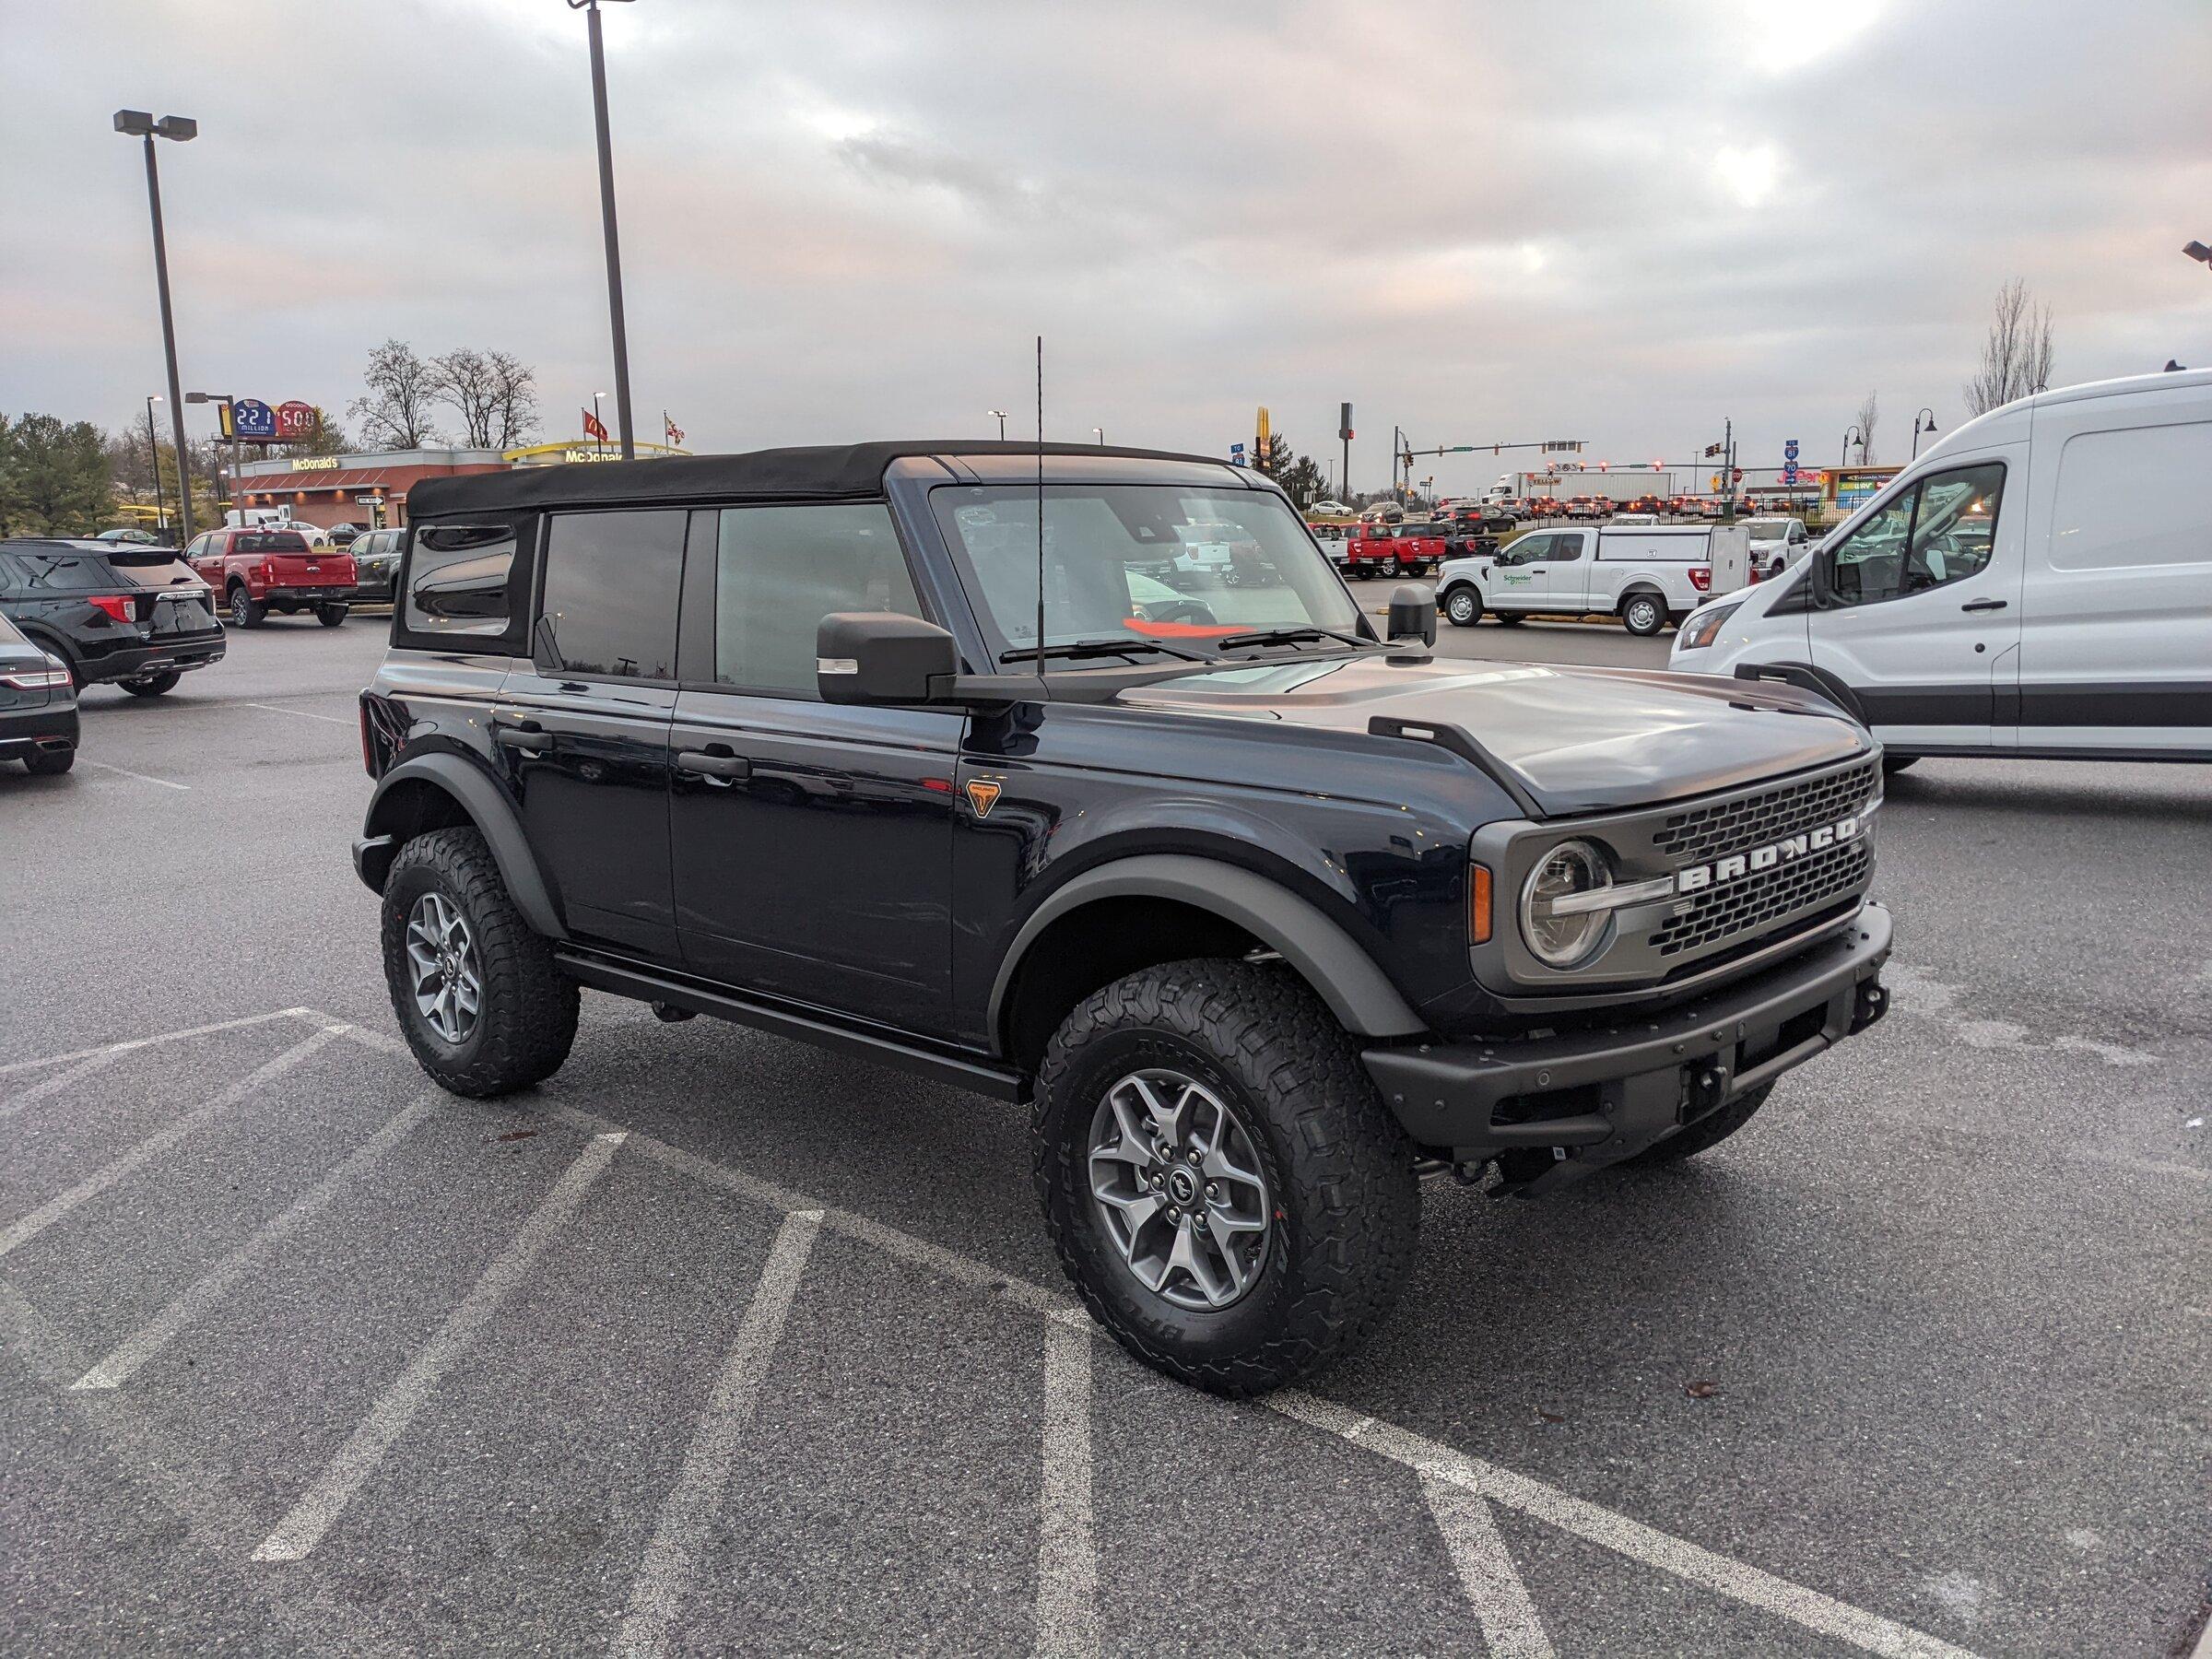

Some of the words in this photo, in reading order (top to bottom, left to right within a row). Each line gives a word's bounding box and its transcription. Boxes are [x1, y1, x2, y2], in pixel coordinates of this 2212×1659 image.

[292, 457, 338, 470] McDonald's
[1840, 482, 1873, 490] SUBWAY
[1679, 818, 1857, 892] BRONCO
